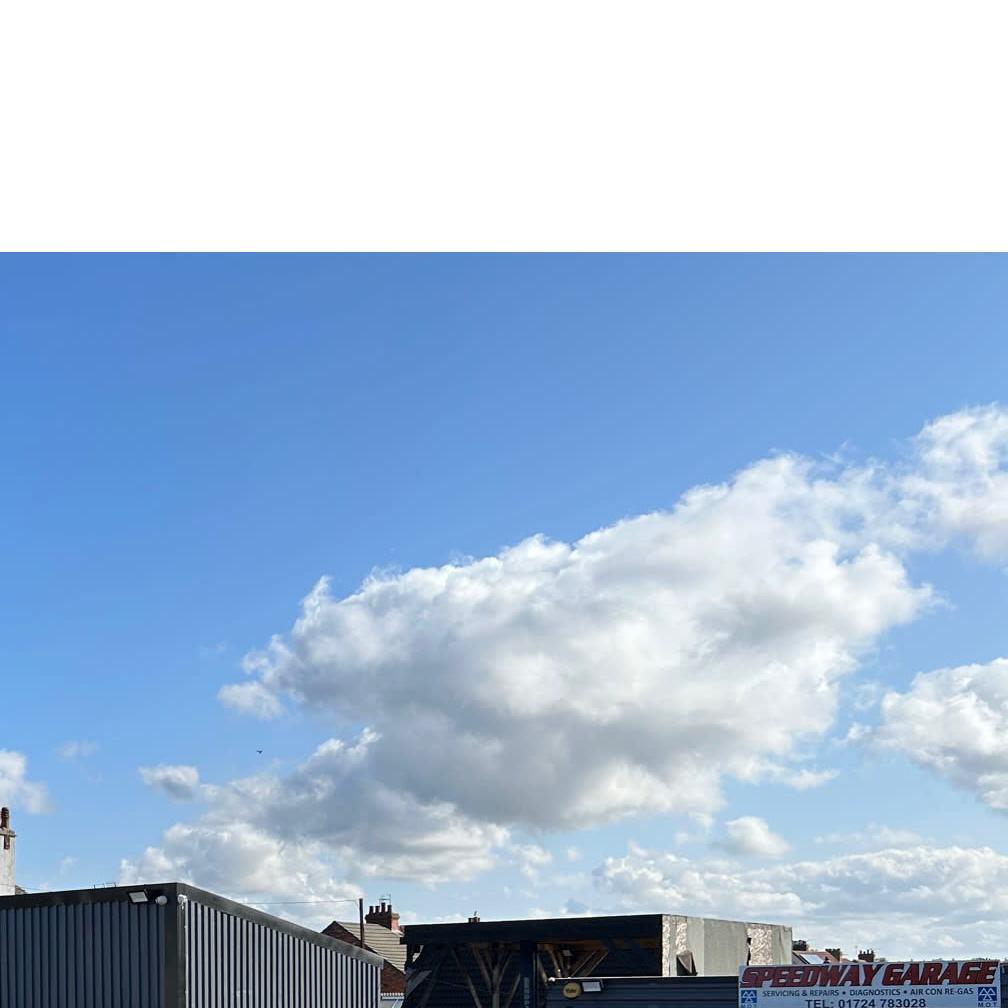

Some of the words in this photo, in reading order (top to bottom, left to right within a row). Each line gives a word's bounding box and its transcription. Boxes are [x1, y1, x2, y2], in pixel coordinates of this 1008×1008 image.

[740, 964, 884, 988] SPEEDWAY
[882, 962, 999, 986] GARAGE
[849, 988, 901, 996] DIAGNOSTICS
[944, 987, 974, 995] RE-GAS
[805, 999, 834, 1008] TEL:
[838, 999, 875, 1008] 01724
[880, 998, 926, 1008] 783028
